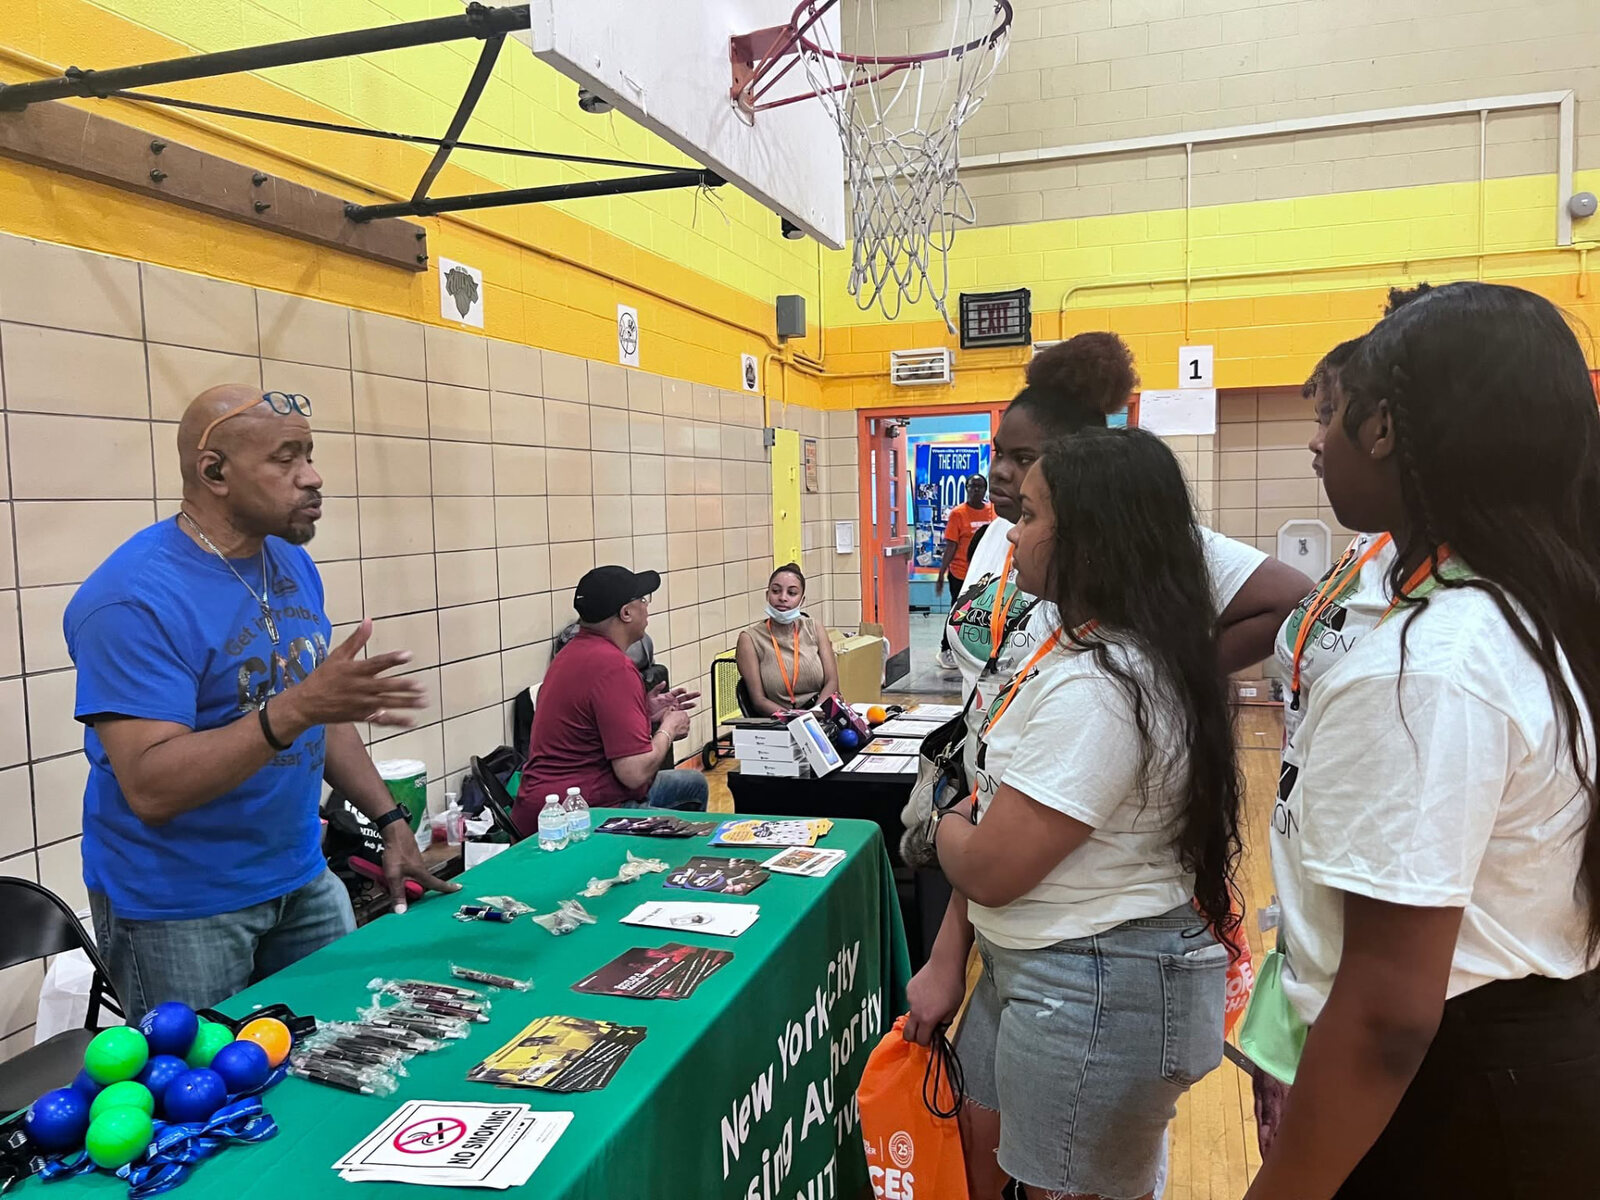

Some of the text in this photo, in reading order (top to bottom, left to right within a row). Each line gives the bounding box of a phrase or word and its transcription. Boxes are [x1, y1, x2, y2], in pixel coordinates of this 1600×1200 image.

[977, 302, 1010, 335] EXIT
[1189, 359, 1202, 380] 1
[938, 454, 971, 470] THE FIRST
[939, 474, 968, 507] 100
[225, 627, 257, 656] Get
[721, 940, 860, 1181] New York City
[745, 1116, 793, 1200] sing
[800, 986, 882, 1142] Auhority
[446, 1110, 512, 1165] NO SMOKING
[897, 1143, 908, 1156] 25
